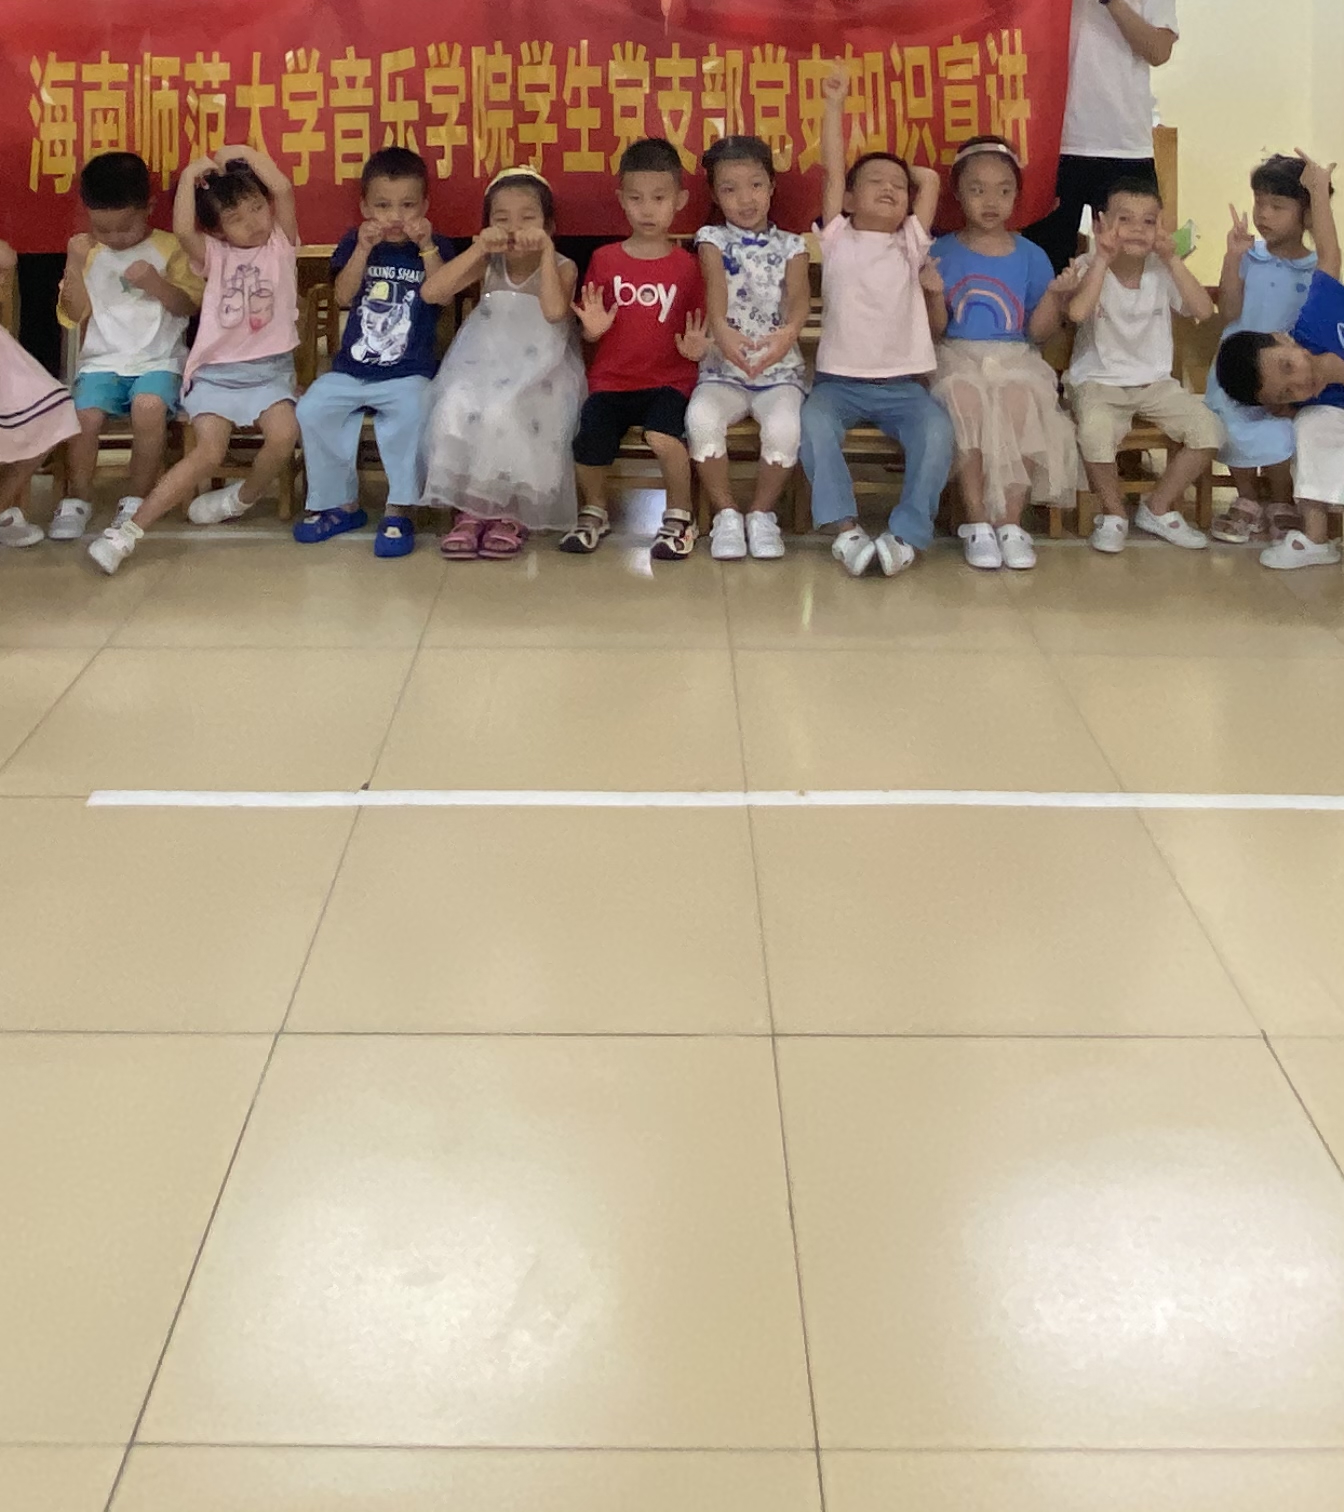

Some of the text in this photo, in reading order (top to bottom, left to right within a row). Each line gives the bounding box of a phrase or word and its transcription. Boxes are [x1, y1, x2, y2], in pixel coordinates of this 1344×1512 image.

[29, 29, 1031, 194] 海南师范大学音乐学院学生党支部党史知识宣讲
[613, 275, 677, 323] boy
